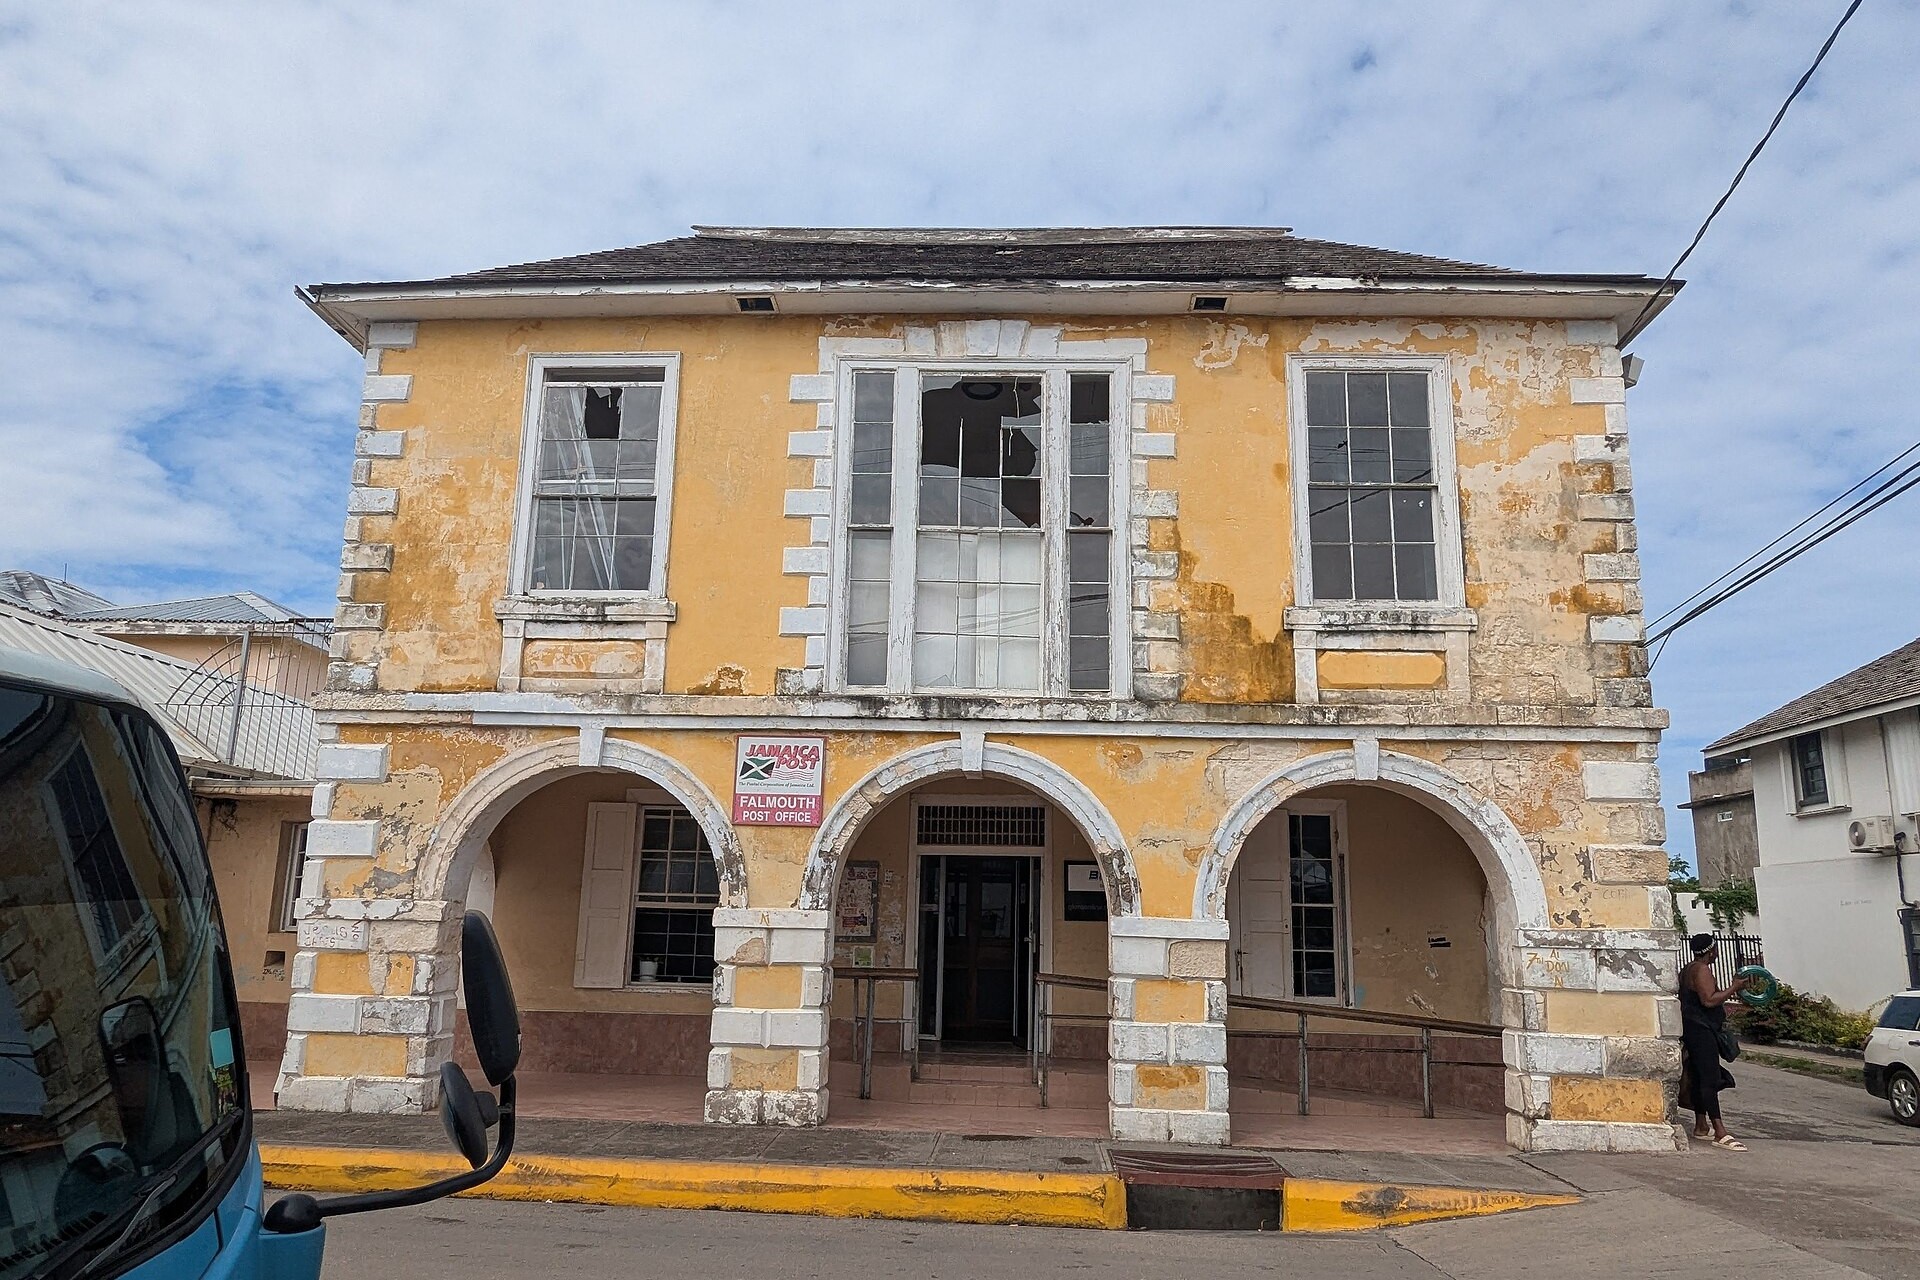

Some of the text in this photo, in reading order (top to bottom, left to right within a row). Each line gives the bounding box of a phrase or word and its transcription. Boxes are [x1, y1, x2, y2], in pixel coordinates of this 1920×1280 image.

[745, 744, 820, 760] JAMAICA
[775, 754, 817, 770] POST
[740, 796, 816, 809] FALMOUTH
[743, 810, 811, 822] POST OFFICE
